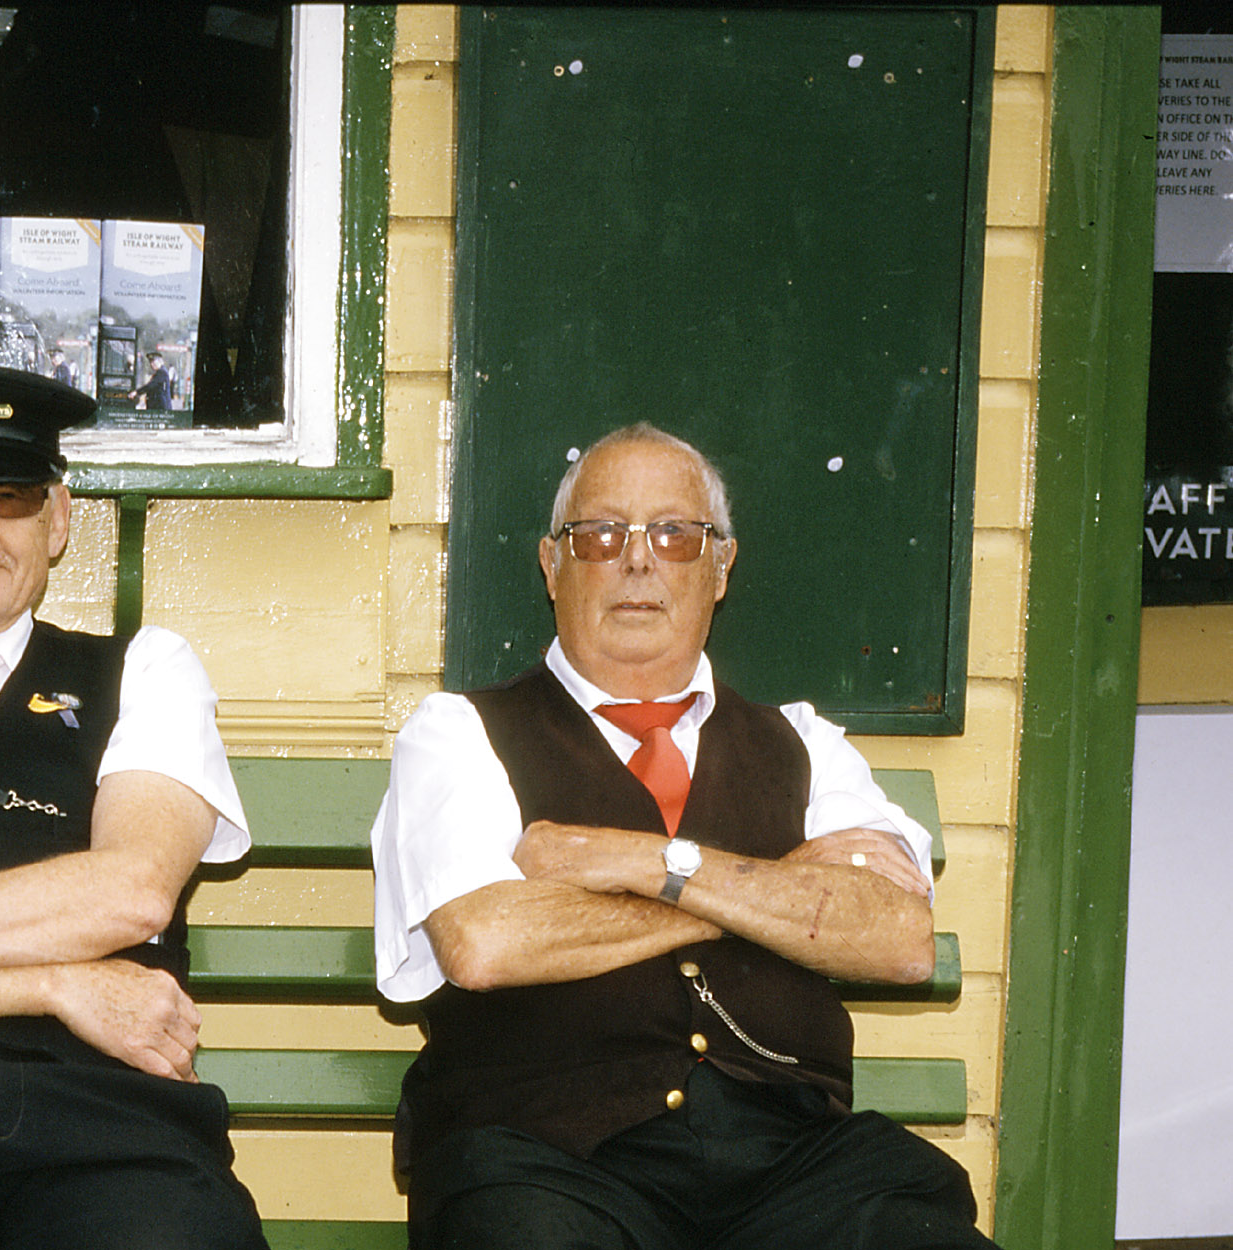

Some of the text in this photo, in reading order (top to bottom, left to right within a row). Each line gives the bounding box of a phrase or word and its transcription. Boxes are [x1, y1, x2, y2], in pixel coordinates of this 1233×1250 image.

[1175, 78, 1199, 88] TAKE
[1203, 78, 1220, 88] ALL
[1196, 96, 1209, 106] TO
[1212, 96, 1230, 106] THE
[1167, 114, 1201, 124] OFFICE
[1205, 114, 1221, 124] ON
[1172, 132, 1193, 141] SIDE
[1197, 132, 1210, 142] OF
[1183, 150, 1207, 160] LINE.
[1210, 150, 1226, 160] DO
[1157, 168, 1212, 178] LEAVE ANY
[1156, 185, 1187, 195] ERIES
[156, 234, 181, 242] WIGHT
[150, 242, 184, 250] RAILWAY
[120, 280, 145, 289] Come
[1147, 484, 1227, 515] AFF
